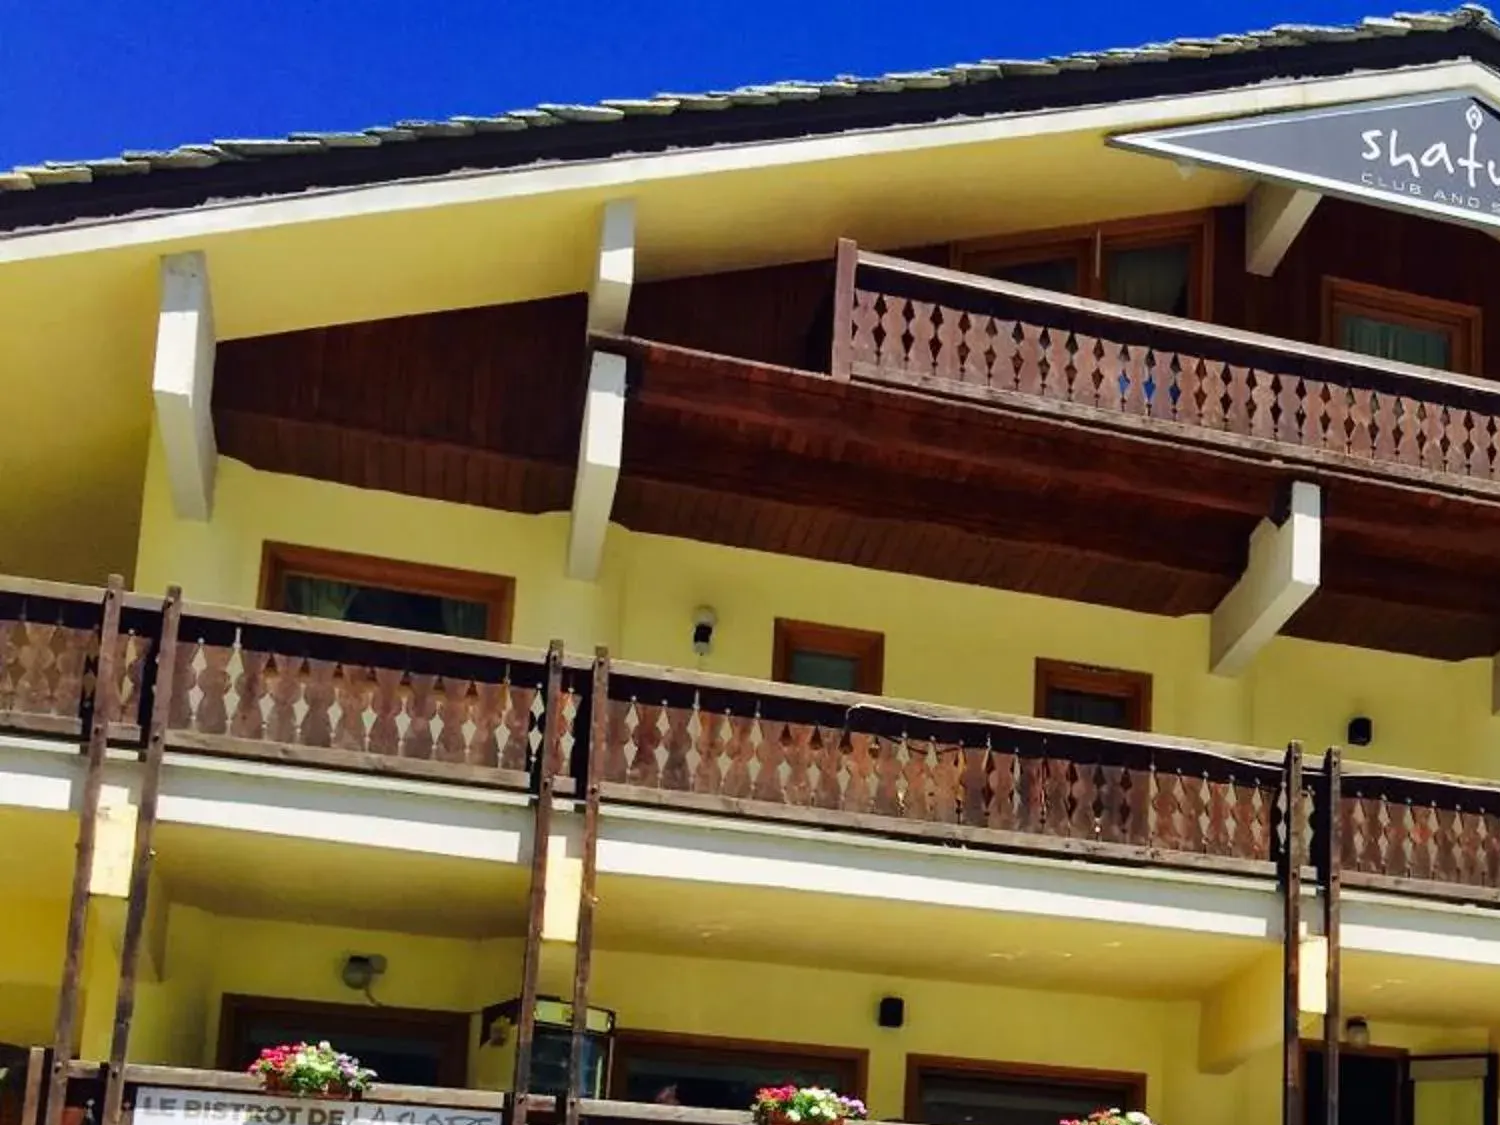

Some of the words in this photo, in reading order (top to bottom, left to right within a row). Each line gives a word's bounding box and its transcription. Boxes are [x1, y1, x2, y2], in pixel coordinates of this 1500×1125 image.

[1361, 172, 1423, 196] CLUB
[1433, 190, 1481, 210] AND
[143, 1096, 177, 1117] LE
[184, 1098, 302, 1125] BISTROT
